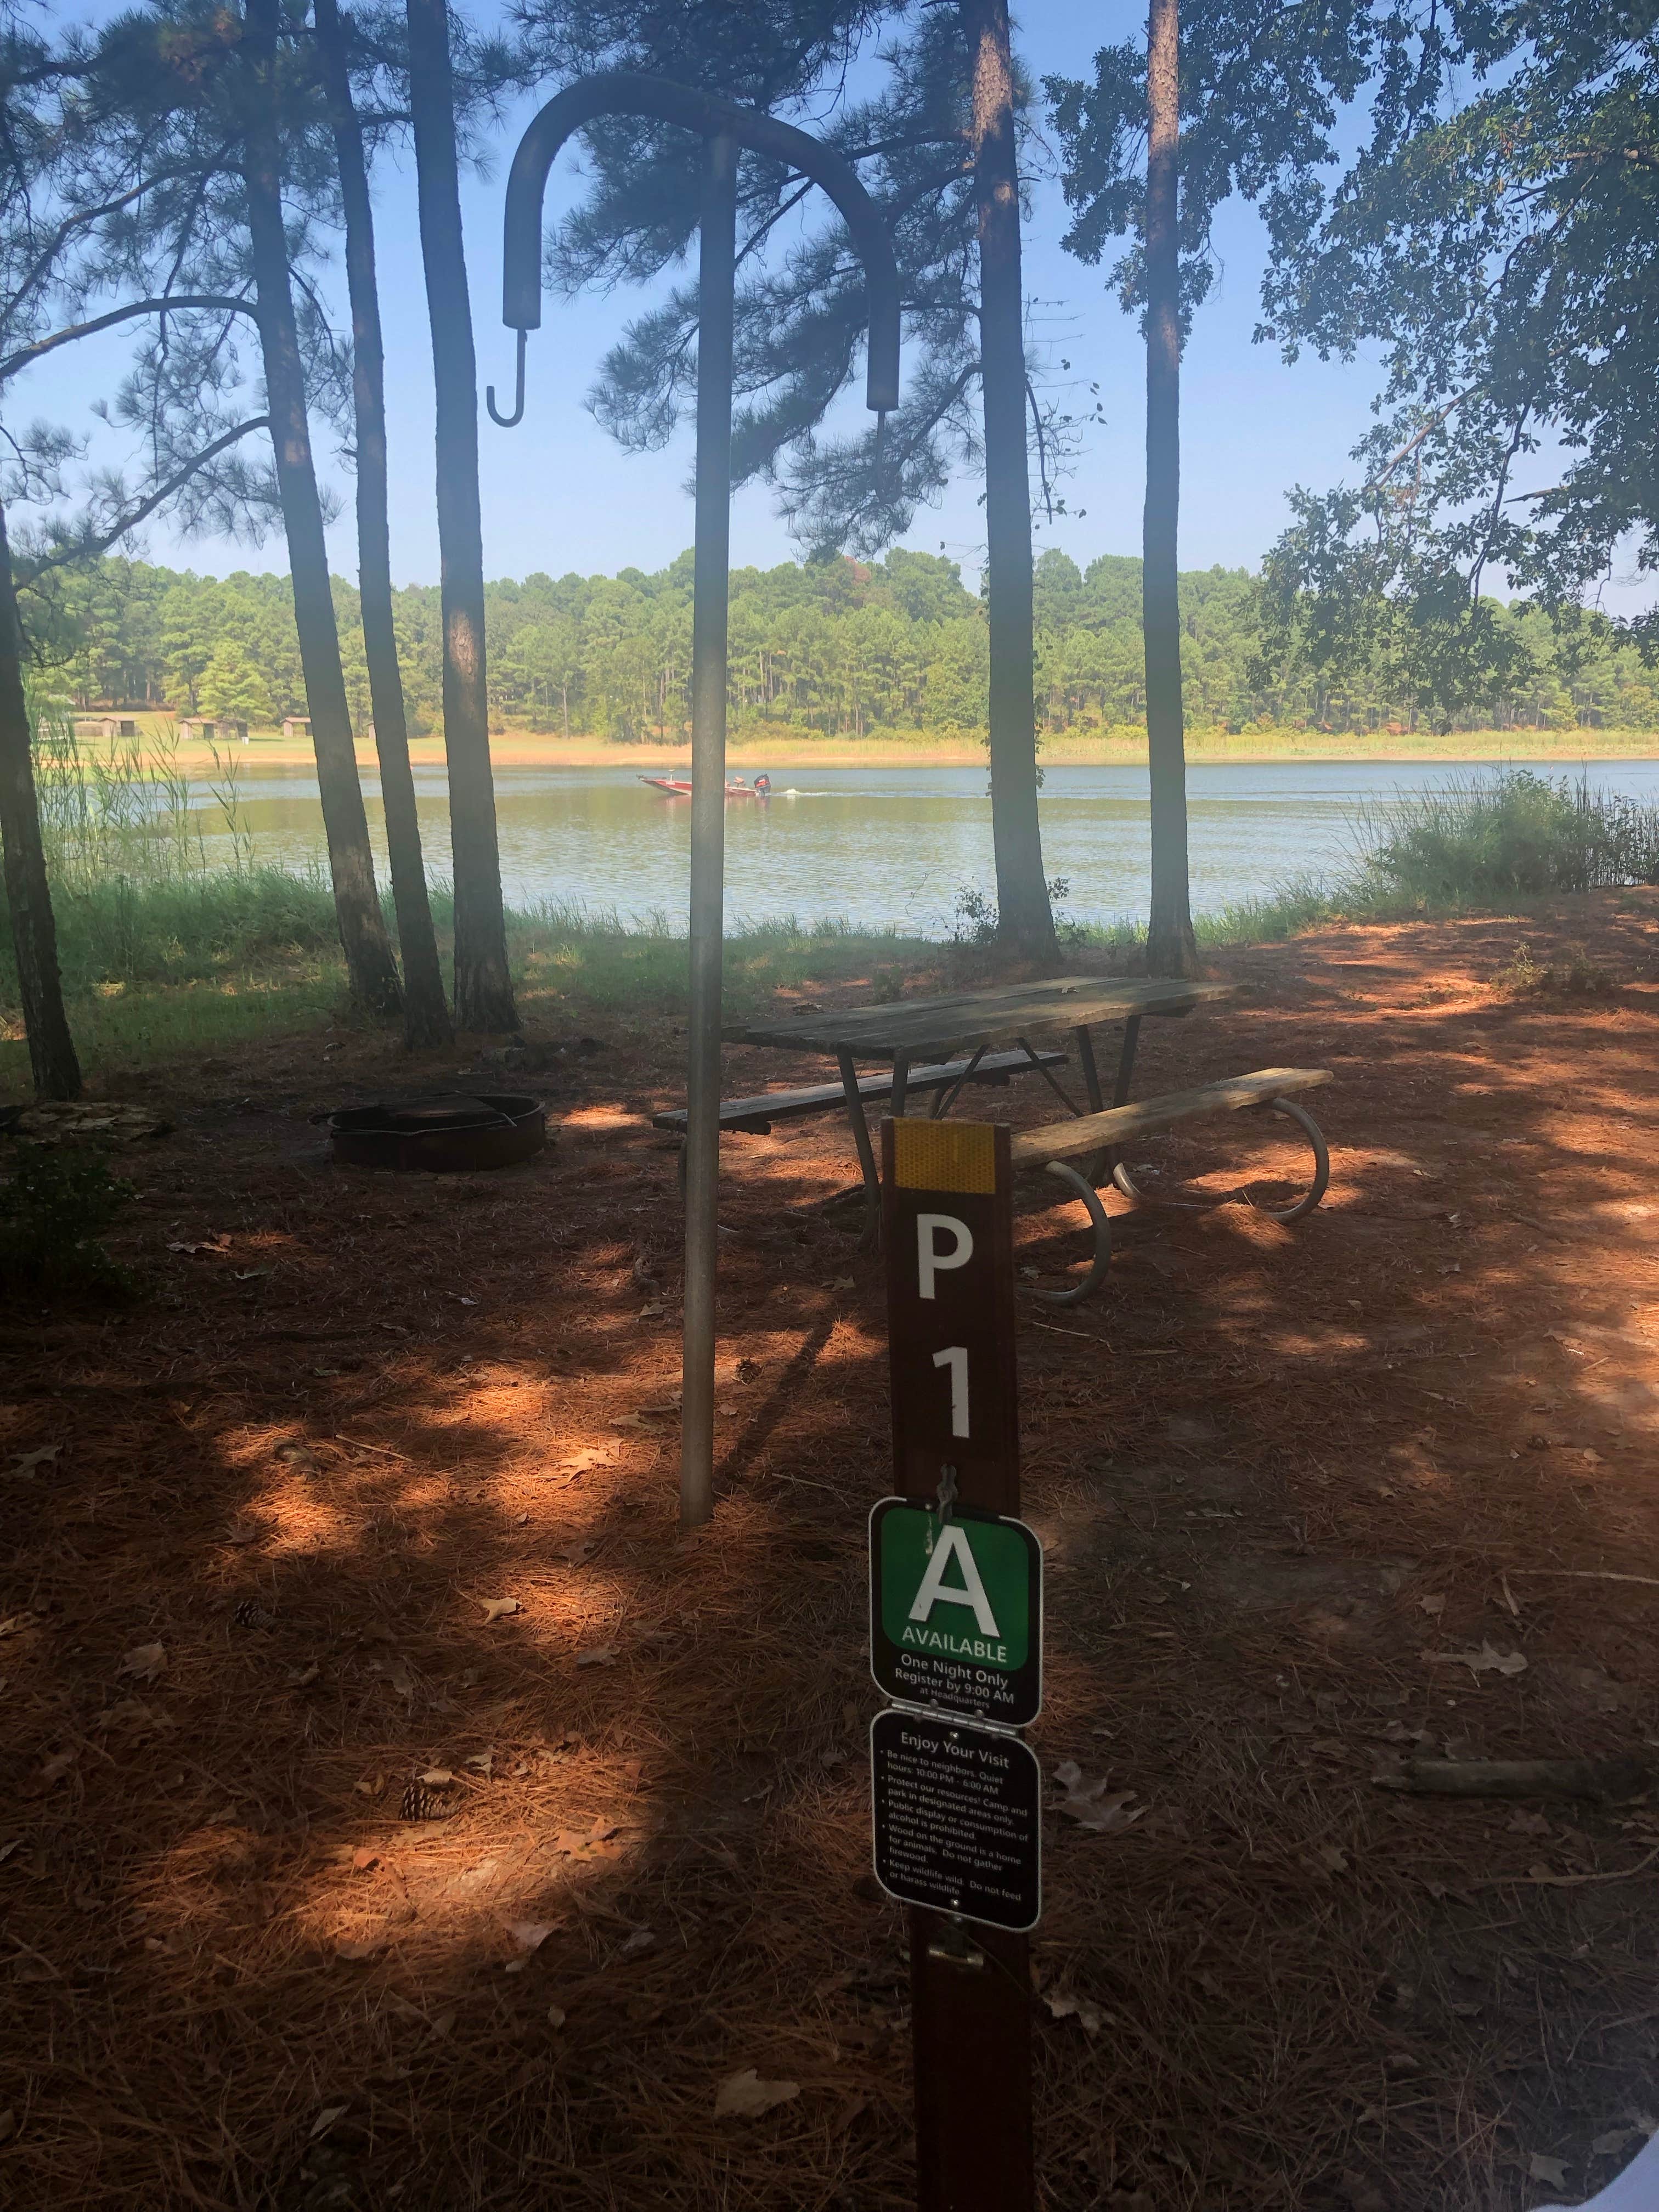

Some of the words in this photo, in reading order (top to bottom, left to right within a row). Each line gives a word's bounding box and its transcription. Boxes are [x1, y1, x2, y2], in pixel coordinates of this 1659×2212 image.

[917, 1213, 973, 1299] P
[933, 1346, 969, 1438] 1
[909, 1525, 1000, 1638] A
[902, 1626, 1007, 1663] AVAILABLE
[895, 1667, 943, 1685] Register
[946, 1679, 961, 1694] by
[964, 1683, 990, 1698] 9:00
[993, 1690, 1014, 1704] AM
[901, 1654, 928, 1669] One
[933, 1660, 972, 1680] Night
[975, 1670, 1008, 1690] Only
[931, 1689, 990, 1708] Headquarters
[887, 1749, 898, 1759] Be
[900, 1753, 918, 1763] nice
[920, 1757, 929, 1766] to
[979, 1771, 1003, 1785] Quiet
[901, 1731, 939, 1753] Enjoy
[943, 1740, 975, 1759] Your
[979, 1749, 1009, 1768] Visit
[888, 1775, 918, 1788] Protect
[920, 1784, 935, 1793] our
[983, 1799, 1008, 1812] Camp
[1011, 1807, 1028, 1817] and
[916, 1768, 938, 1779] 10:00
[940, 1773, 954, 1784] PM
[983, 1785, 998, 1795] AM
[888, 1788, 907, 1798] park
[909, 1792, 917, 1800] in
[919, 1795, 966, 1812] designated
[968, 1808, 991, 1819] areas
[888, 1812, 919, 1825] alcohol
[889, 1799, 913, 1812] Public
[916, 1807, 946, 1821] display
[960, 1818, 1017, 1839] consumption
[1019, 1833, 1029, 1842] of
[889, 1823, 913, 1836] Wood
[929, 1835, 944, 1844] the
[946, 1839, 977, 1853] ground
[980, 1846, 986, 1855] is
[996, 1851, 1021, 1864] home
[889, 1835, 901, 1844] for
[943, 1848, 955, 1858] Do
[957, 1854, 972, 1864] not
[974, 1859, 1002, 1871] gather
[889, 1859, 910, 1871] Keep
[912, 1866, 943, 1880] wildlife
[970, 1880, 983, 1890] Do
[985, 1886, 999, 1895] not
[1002, 1888, 1022, 1900] feed
[900, 1872, 927, 1887] harass
